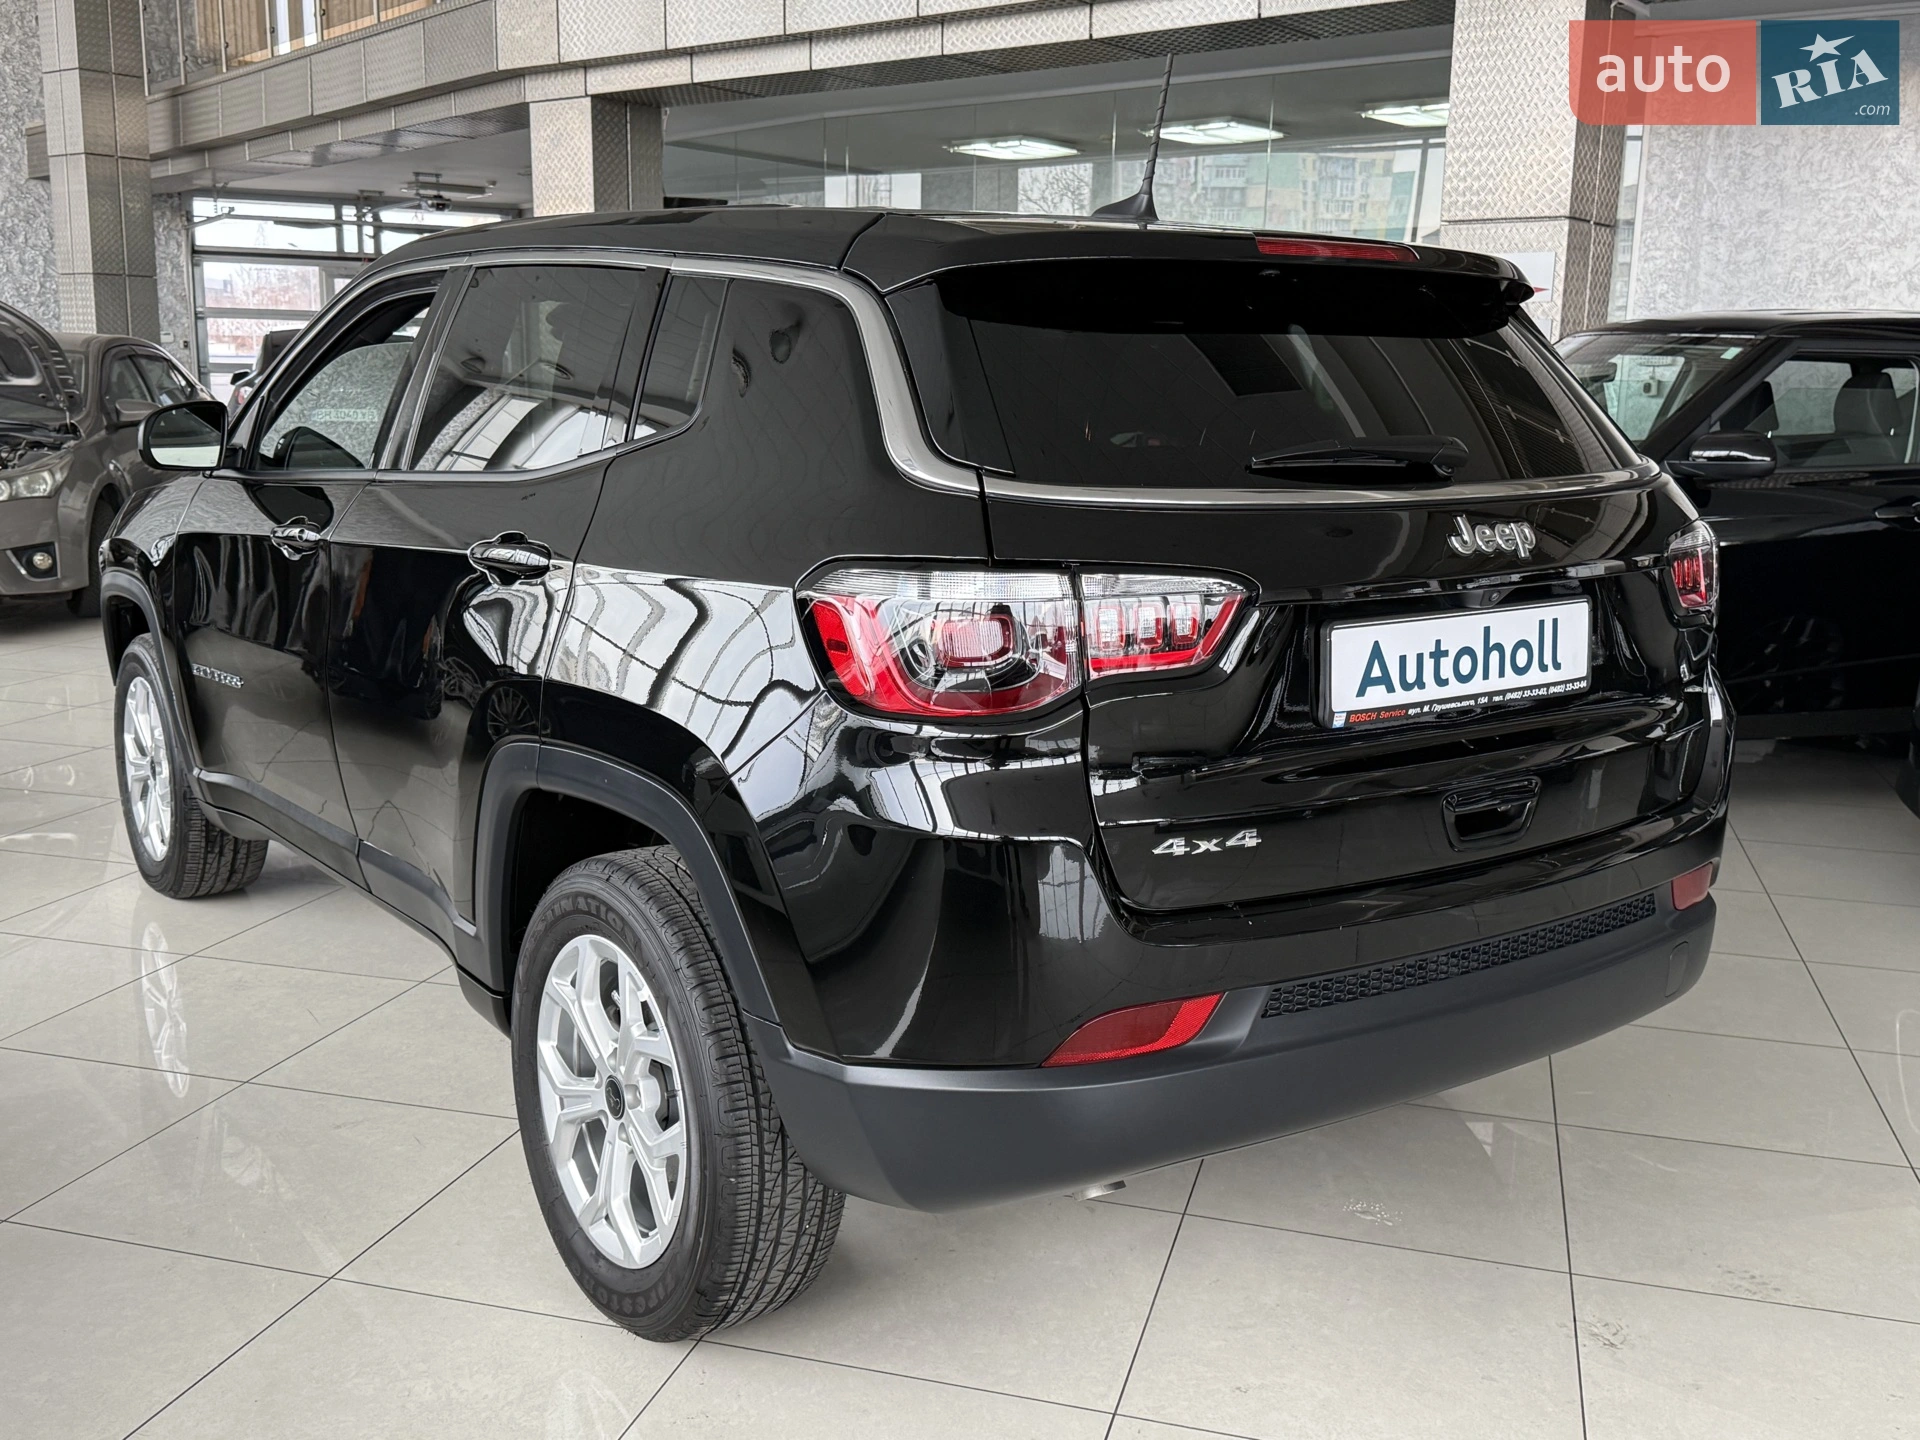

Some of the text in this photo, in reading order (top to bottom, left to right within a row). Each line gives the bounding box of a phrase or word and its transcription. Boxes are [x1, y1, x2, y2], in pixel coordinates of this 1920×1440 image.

[1446, 513, 1537, 560] Jeep
[1355, 617, 1562, 698] Autoholl
[1349, 711, 1378, 723] BOSCH
[1379, 708, 1406, 719] Service
[1151, 826, 1262, 857] 4x4
